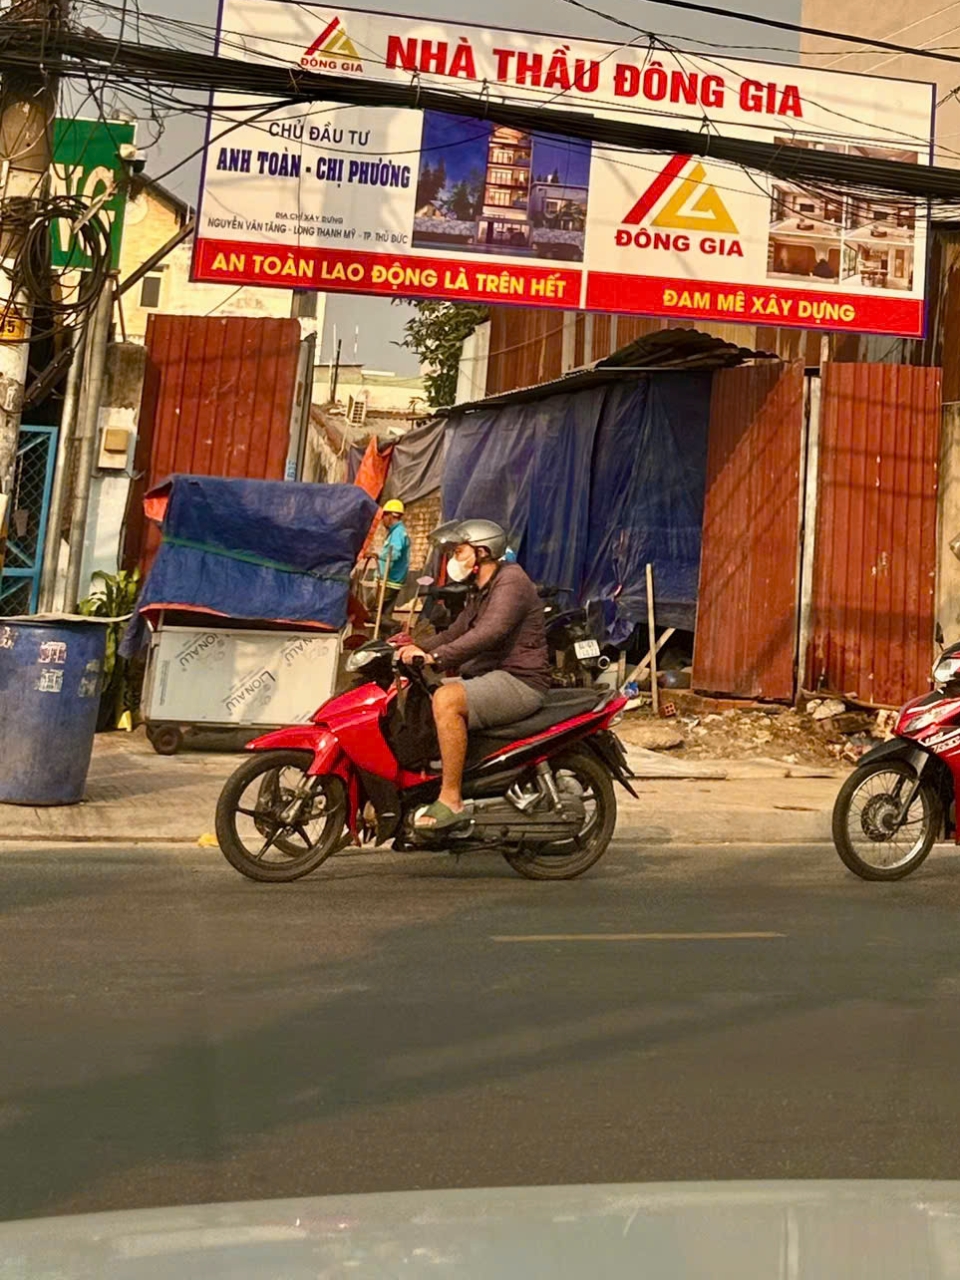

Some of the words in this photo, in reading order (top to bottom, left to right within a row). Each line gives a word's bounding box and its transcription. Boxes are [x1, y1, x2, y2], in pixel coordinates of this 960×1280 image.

[341, 62, 363, 73] GIA
[386, 35, 477, 80] NHÀ
[493, 45, 600, 93] THẦU
[613, 61, 725, 108] ĐÔNG
[739, 80, 803, 117] GIA
[268, 120, 303, 140] CHỦ
[309, 122, 344, 145] ĐẦU
[348, 130, 371, 146] TƯ
[216, 148, 251, 173] ANH
[257, 147, 301, 177] TOÀN
[316, 159, 343, 188] CHỊ
[348, 157, 411, 188] PHƯƠNG
[293, 226, 315, 236] LONG
[614, 227, 690, 253] ĐÔNG
[699, 237, 744, 258] GIA
[211, 253, 243, 272] AN
[252, 251, 315, 278] TOÀN
[321, 260, 364, 281] LAO
[371, 261, 438, 289] ĐỘNG
[444, 267, 469, 291] LÀ
[475, 269, 524, 296] TRÊN
[530, 272, 566, 299] HẾT
[663, 289, 711, 309] ĐAM
[717, 290, 746, 312] MÊ
[751, 293, 792, 316] XÂY
[798, 299, 855, 324] DỰNG
